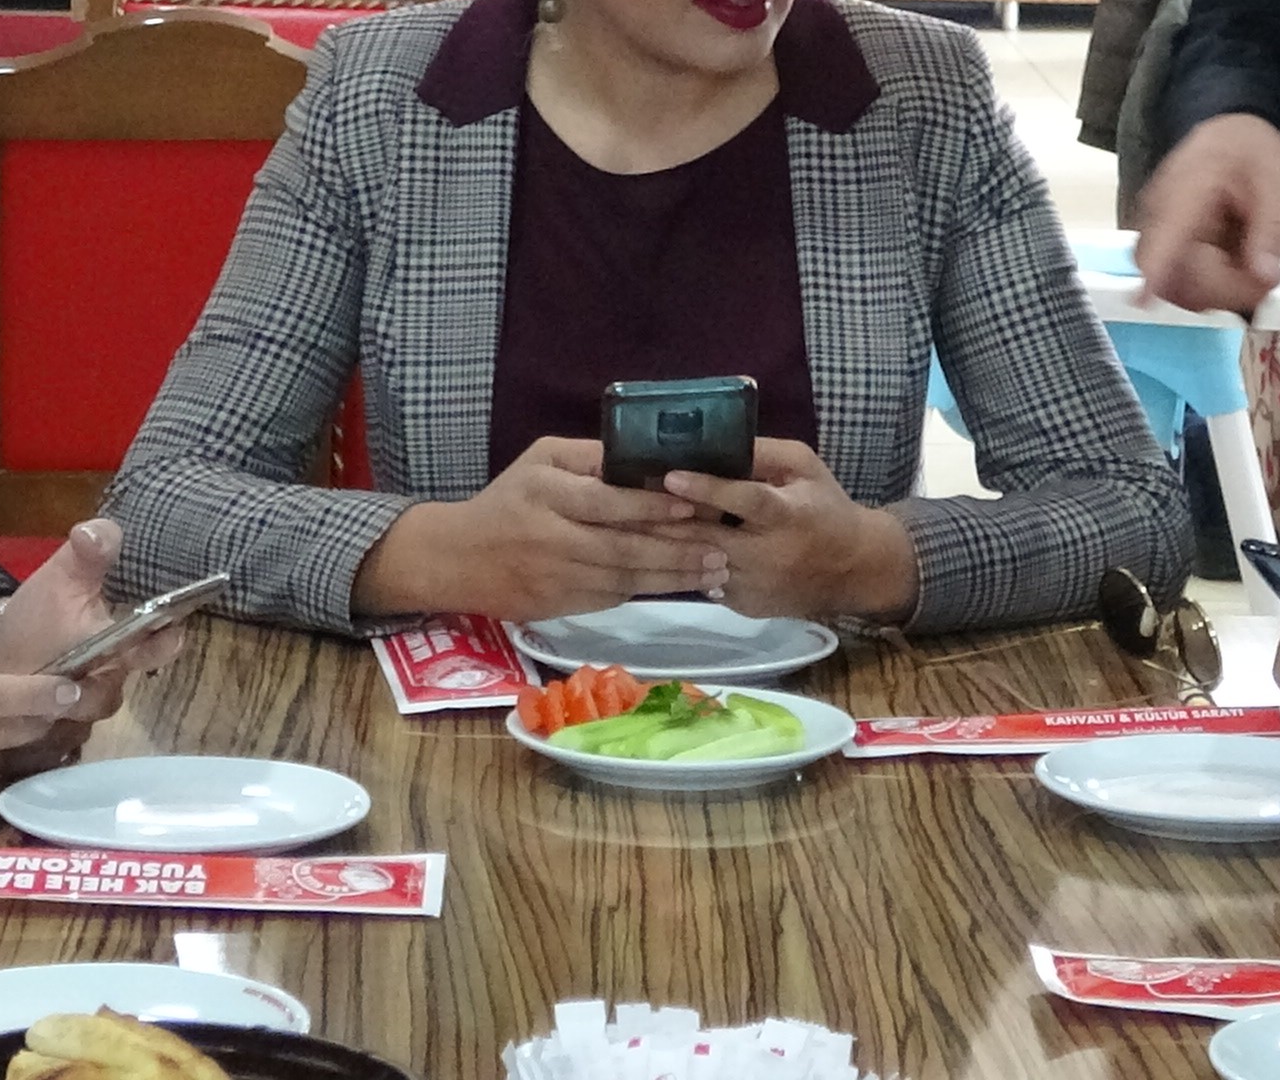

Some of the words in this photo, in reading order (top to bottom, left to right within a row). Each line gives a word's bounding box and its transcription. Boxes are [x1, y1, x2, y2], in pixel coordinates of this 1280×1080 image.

[1045, 714, 1116, 726] KAHVALTI
[1119, 713, 1131, 723] &
[1134, 709, 1189, 722] KÜLTÜR
[1191, 707, 1245, 719] SARAYI
[99, 860, 208, 880] YUSUF
[44, 874, 125, 893] HELE
[135, 878, 207, 896] BAK
